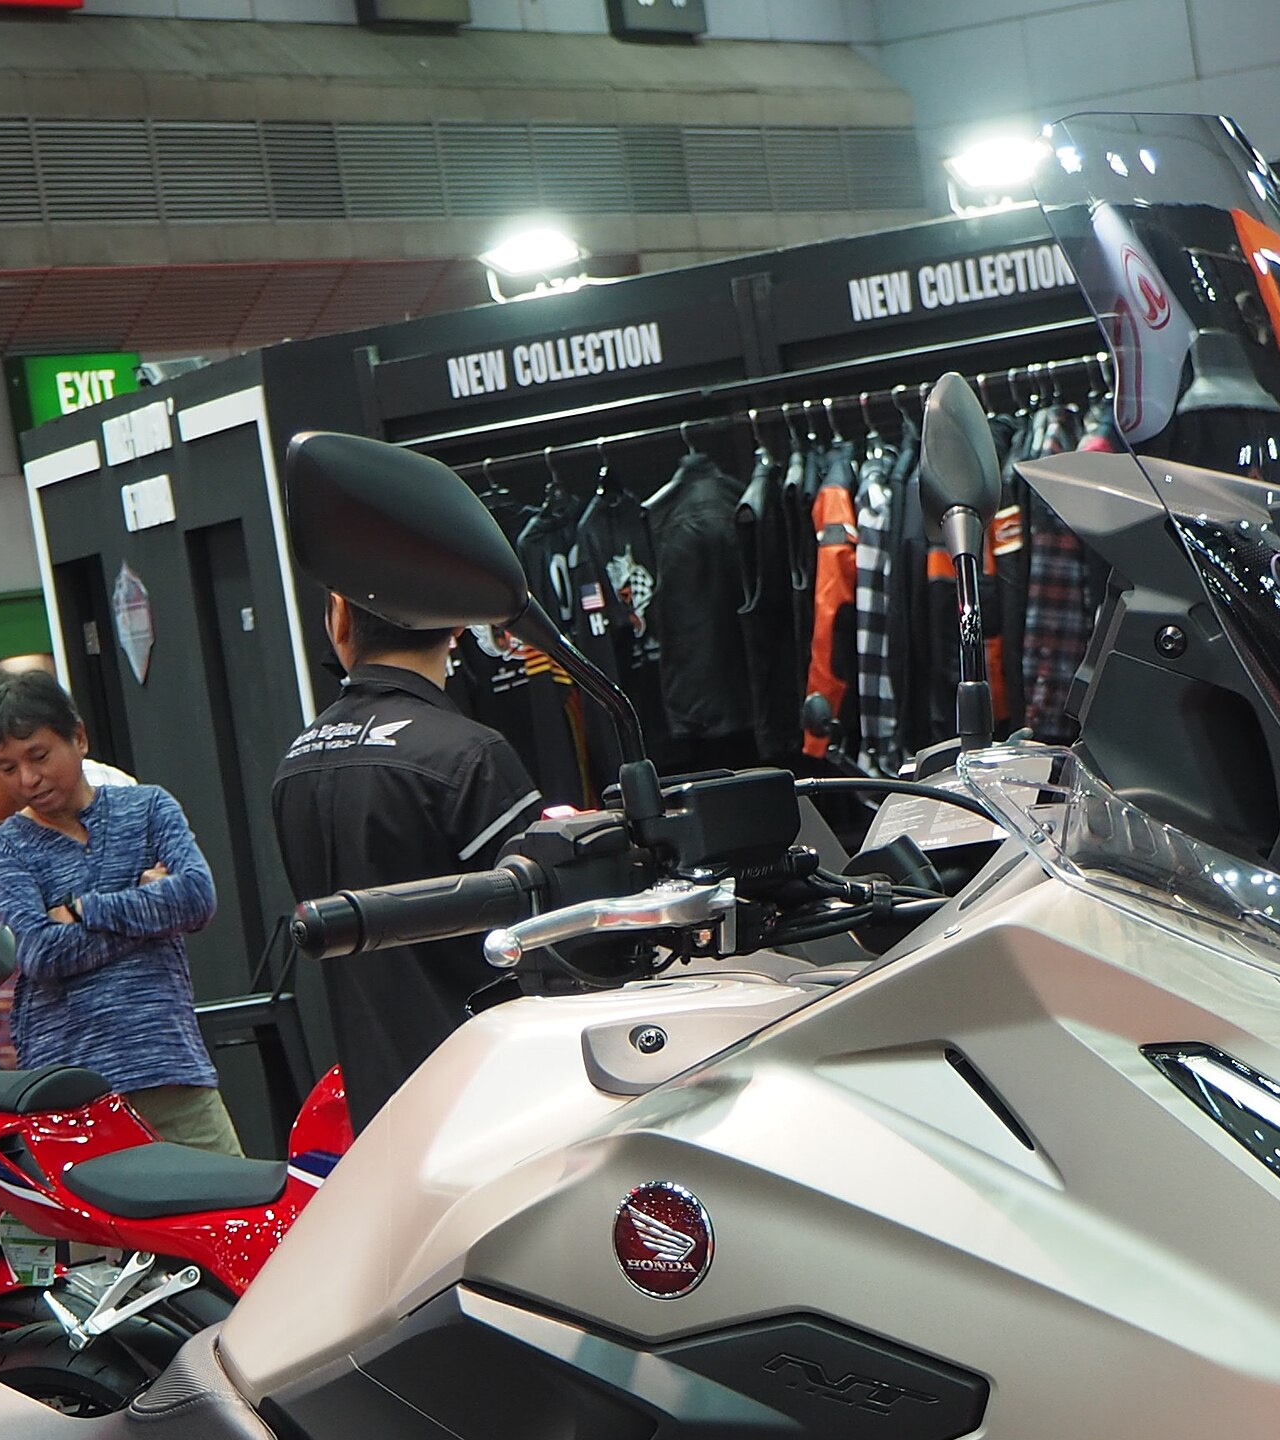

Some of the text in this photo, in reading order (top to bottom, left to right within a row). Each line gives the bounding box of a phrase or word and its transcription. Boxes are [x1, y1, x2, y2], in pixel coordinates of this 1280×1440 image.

[848, 243, 1076, 322] NEW COLLECTION
[446, 322, 663, 399] NEW COLLECTION
[55, 368, 116, 416] EXIT
[625, 1258, 697, 1273] HONDA
